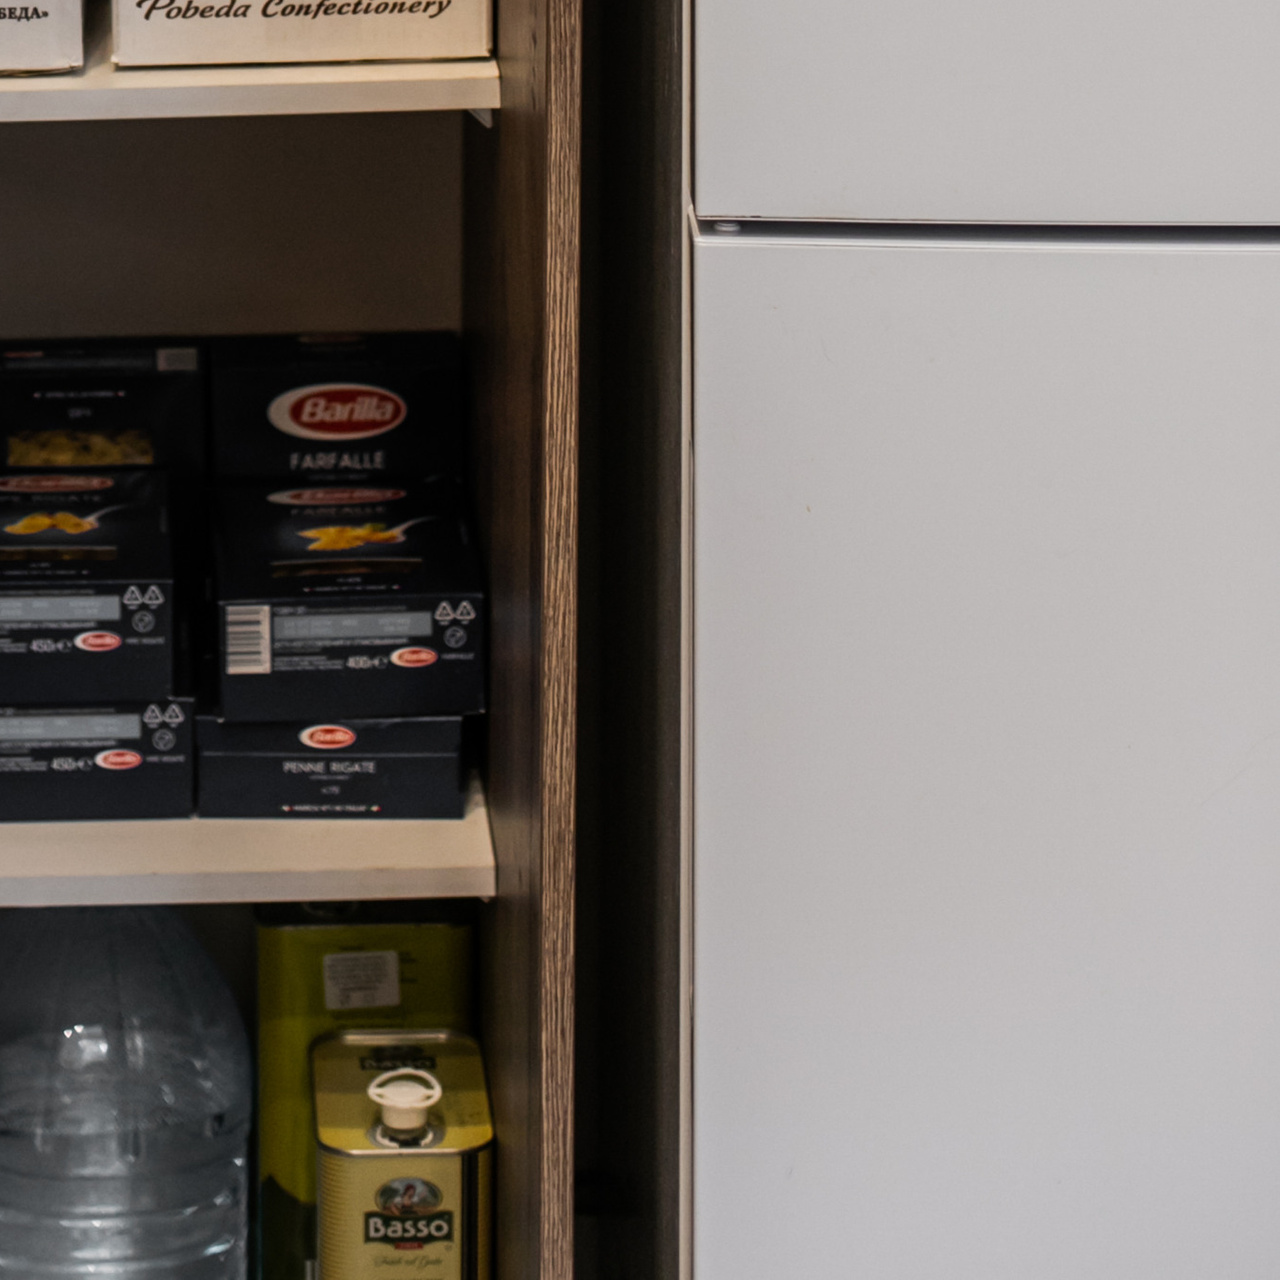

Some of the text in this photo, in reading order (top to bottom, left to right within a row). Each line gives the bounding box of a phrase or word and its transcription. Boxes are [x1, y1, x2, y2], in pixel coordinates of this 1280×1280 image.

[299, 394, 396, 424] Barilla
[290, 448, 386, 471] FARFALLE
[368, 1216, 449, 1238] Basso
